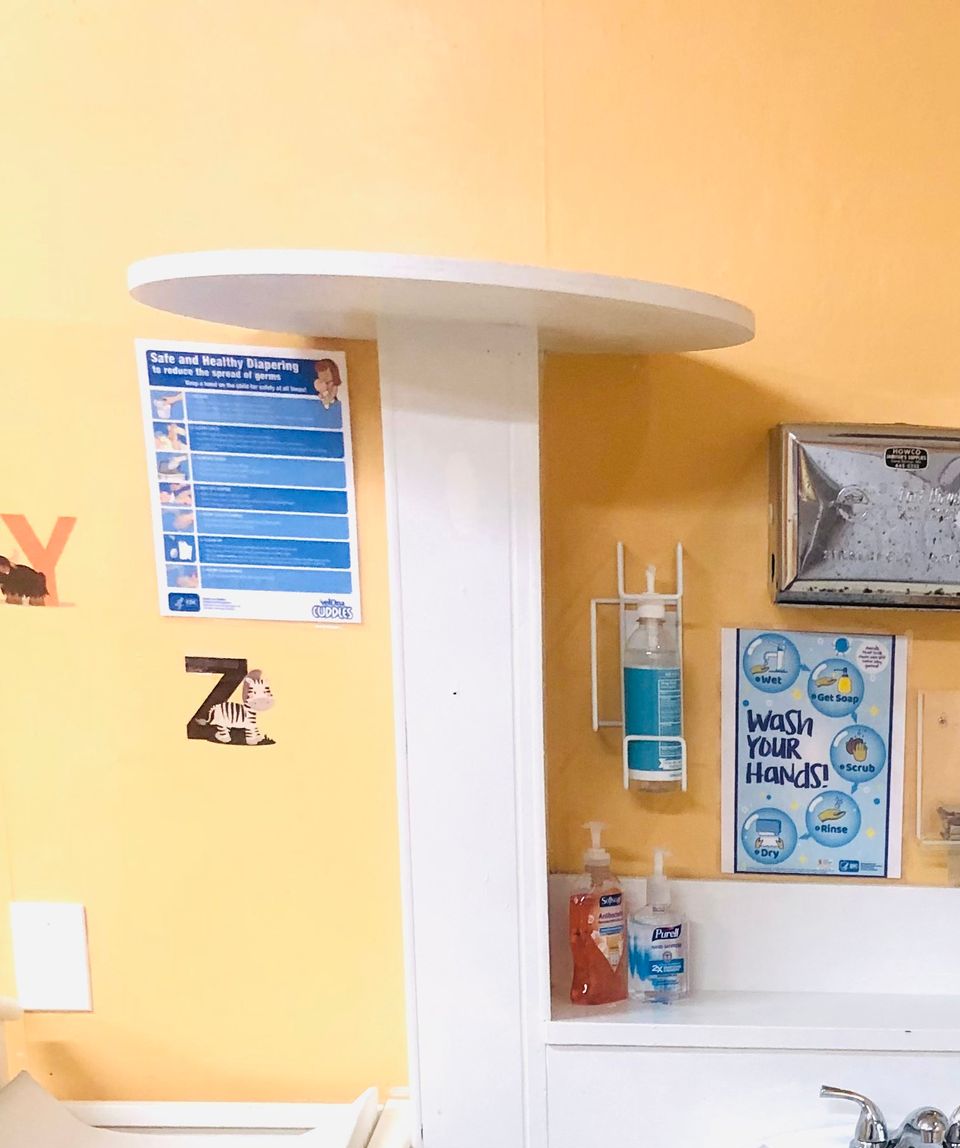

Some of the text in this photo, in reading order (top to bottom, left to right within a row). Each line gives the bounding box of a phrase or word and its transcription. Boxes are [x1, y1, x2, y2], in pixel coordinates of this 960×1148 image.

[150, 352, 300, 373] Safe and Healthy Diapering
[152, 365, 282, 382] to reduce the spread of germs
[1, 514, 77, 607] Y
[312, 605, 353, 620] CUDDLES
[761, 675, 782, 685] Wet
[185, 656, 255, 742] Z
[817, 693, 859, 705] Get Soap
[746, 709, 814, 737] Wash
[746, 735, 802, 761] YOUR
[846, 763, 876, 773] Scrub
[820, 824, 849, 834] Rinse
[760, 848, 780, 860] Dry
[655, 927, 680, 939] Purell
